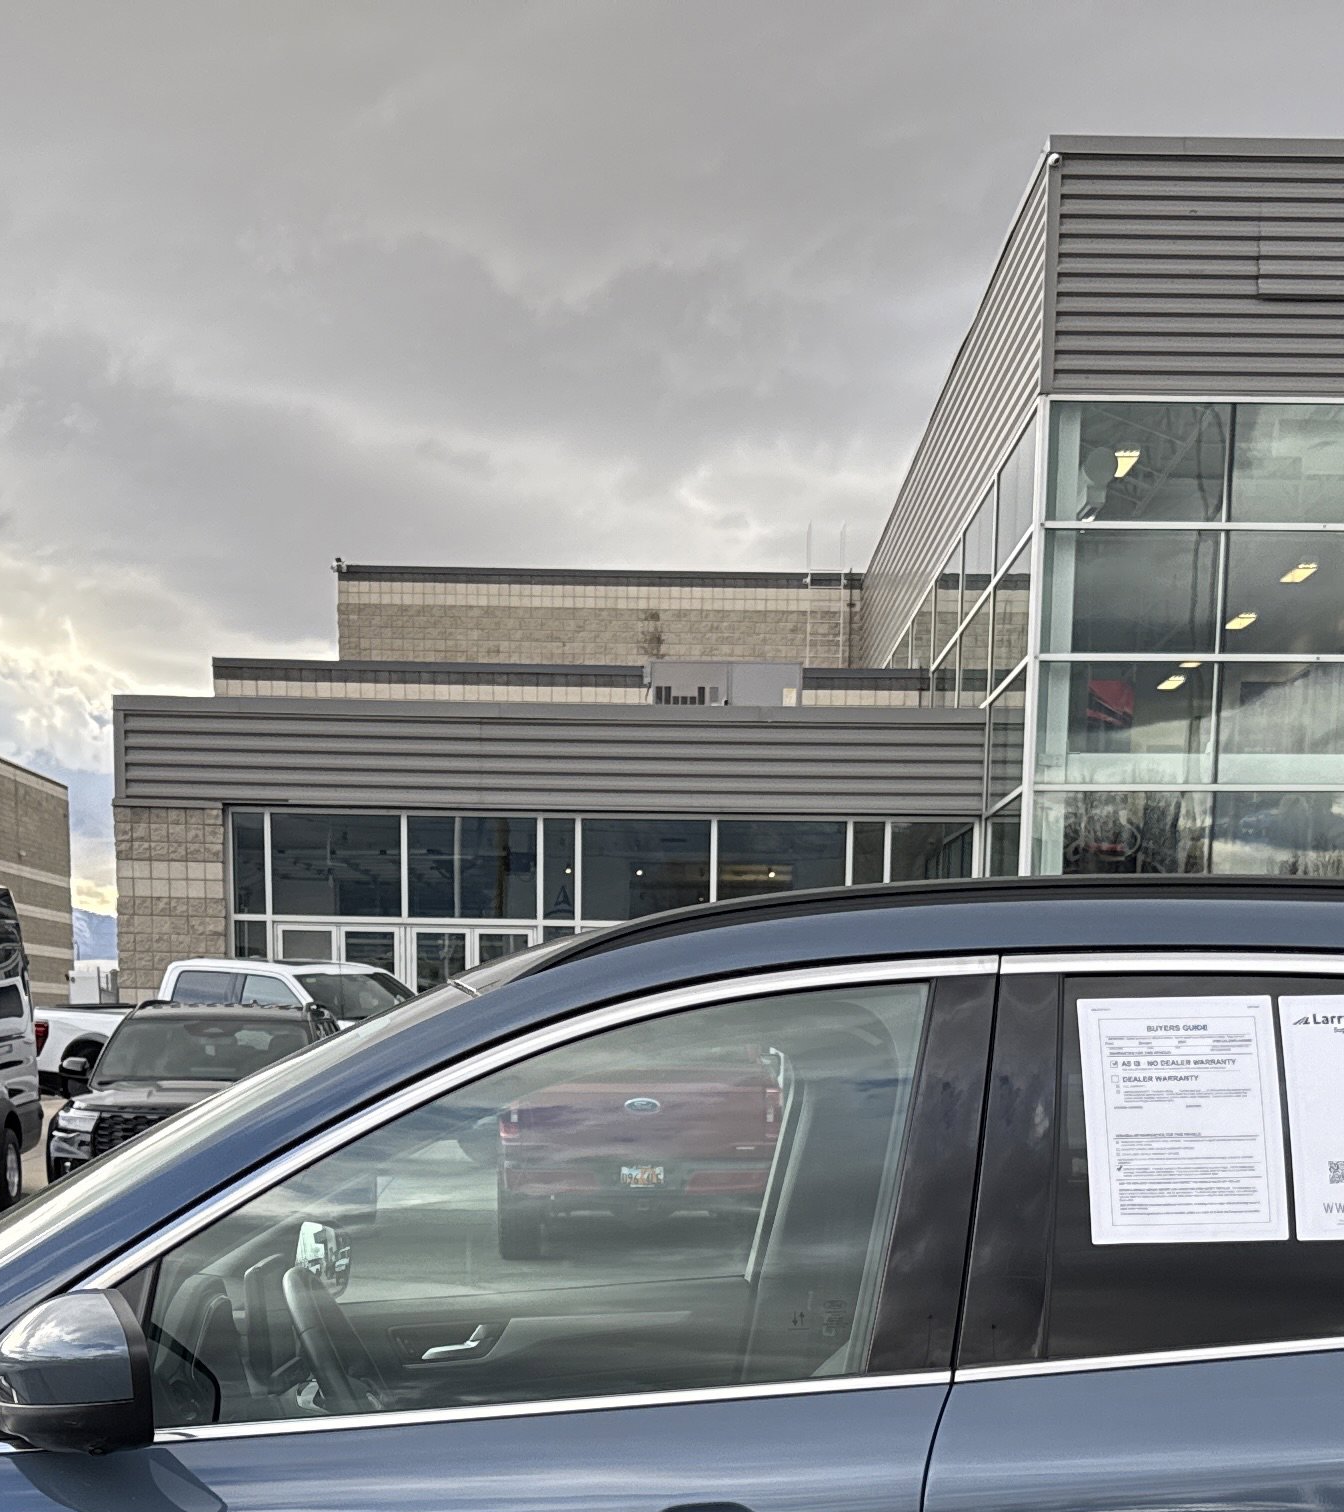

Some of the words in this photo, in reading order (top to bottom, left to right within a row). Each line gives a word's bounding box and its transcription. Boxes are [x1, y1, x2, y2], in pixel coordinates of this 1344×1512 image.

[1146, 1024, 1181, 1033] BUYERS
[1182, 1024, 1208, 1032] GUIDE
[1160, 1059, 1192, 1067] DEALER
[1193, 1058, 1237, 1066] WARRANTY
[1122, 1075, 1154, 1083] DEALER
[1155, 1074, 1199, 1083] WARRANTY
